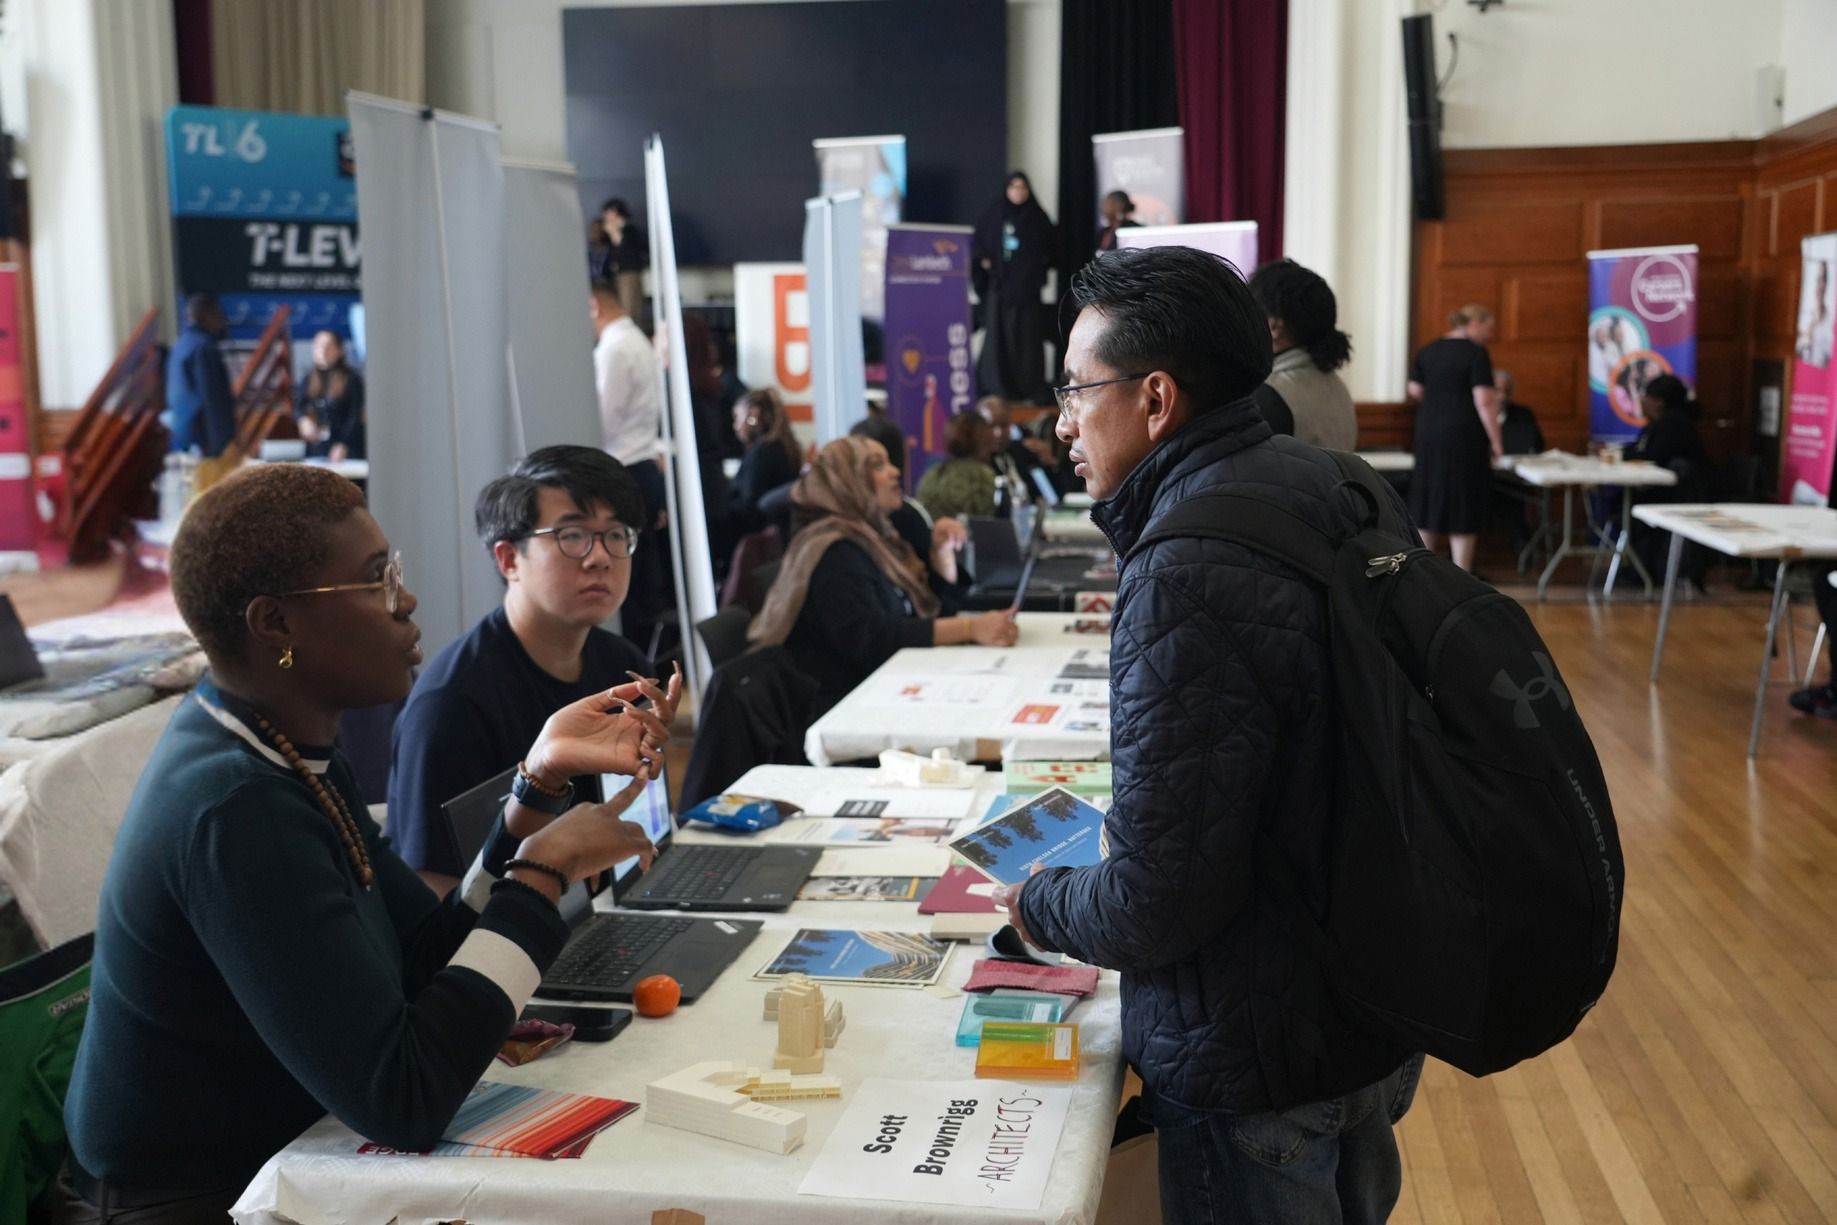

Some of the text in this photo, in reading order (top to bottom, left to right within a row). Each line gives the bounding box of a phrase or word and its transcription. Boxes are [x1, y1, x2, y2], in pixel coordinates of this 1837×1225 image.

[1567, 769, 1606, 852] UNDER
[862, 1114, 909, 1155] Scott
[912, 1098, 979, 1177] Brownrigg
